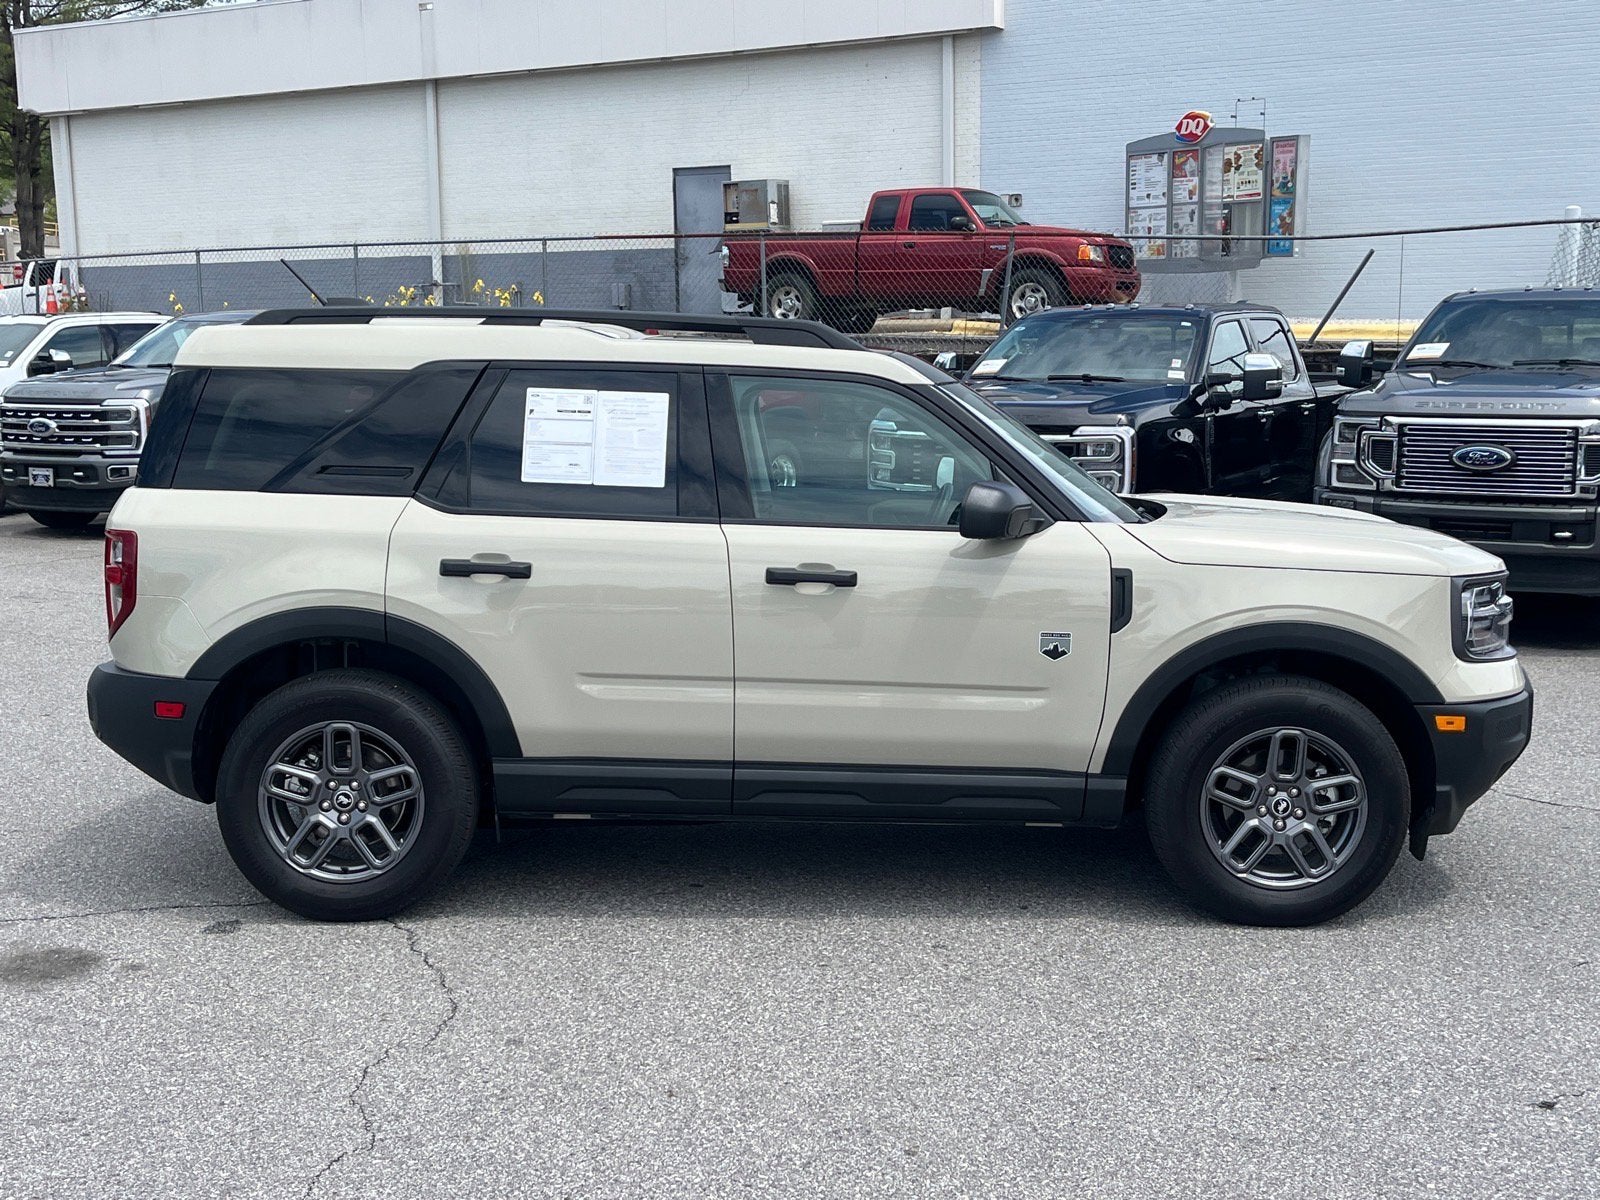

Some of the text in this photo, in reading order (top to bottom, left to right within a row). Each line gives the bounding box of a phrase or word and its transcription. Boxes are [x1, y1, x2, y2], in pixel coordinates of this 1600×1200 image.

[1180, 118, 1205, 135] DQ
[1415, 401, 1567, 410] SUPER DUTY
[1465, 451, 1498, 465] Ford
